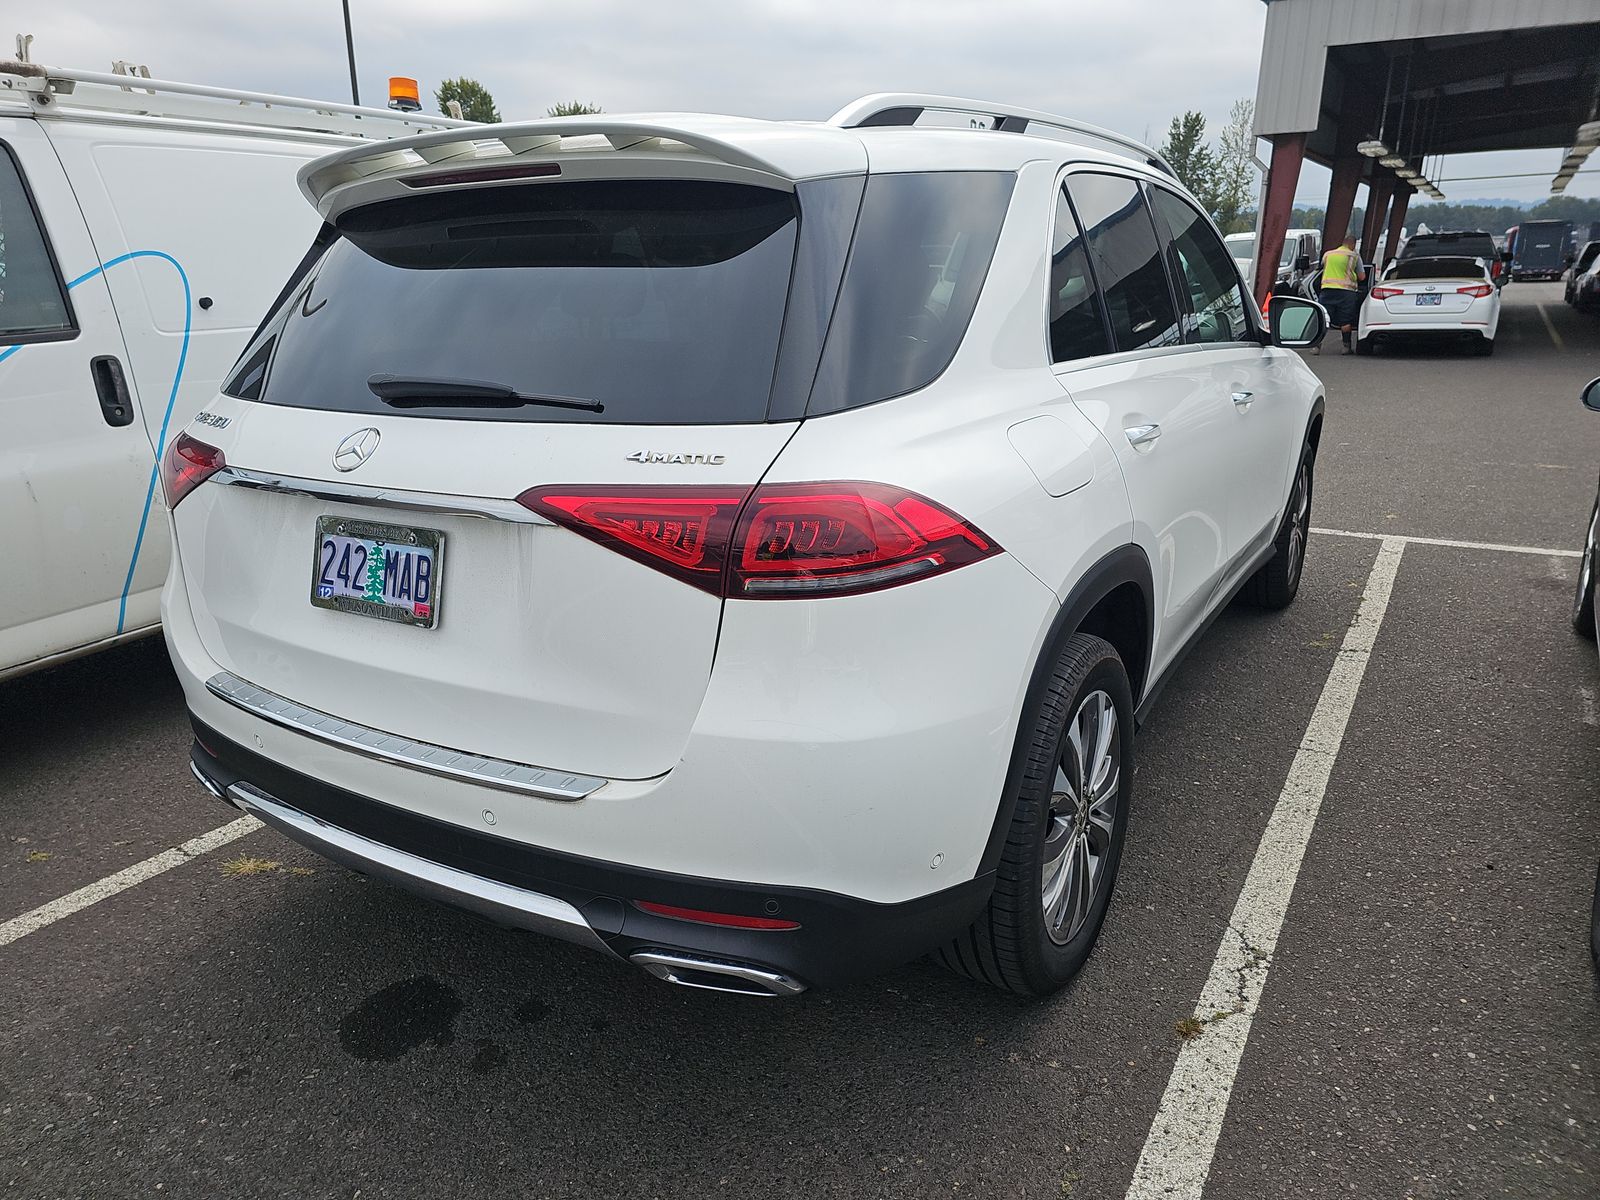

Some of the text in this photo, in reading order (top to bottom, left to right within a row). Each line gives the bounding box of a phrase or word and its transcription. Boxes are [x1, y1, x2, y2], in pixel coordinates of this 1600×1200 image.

[624, 450, 725, 465] 4MATIC
[320, 540, 431, 602] 242 MAB
